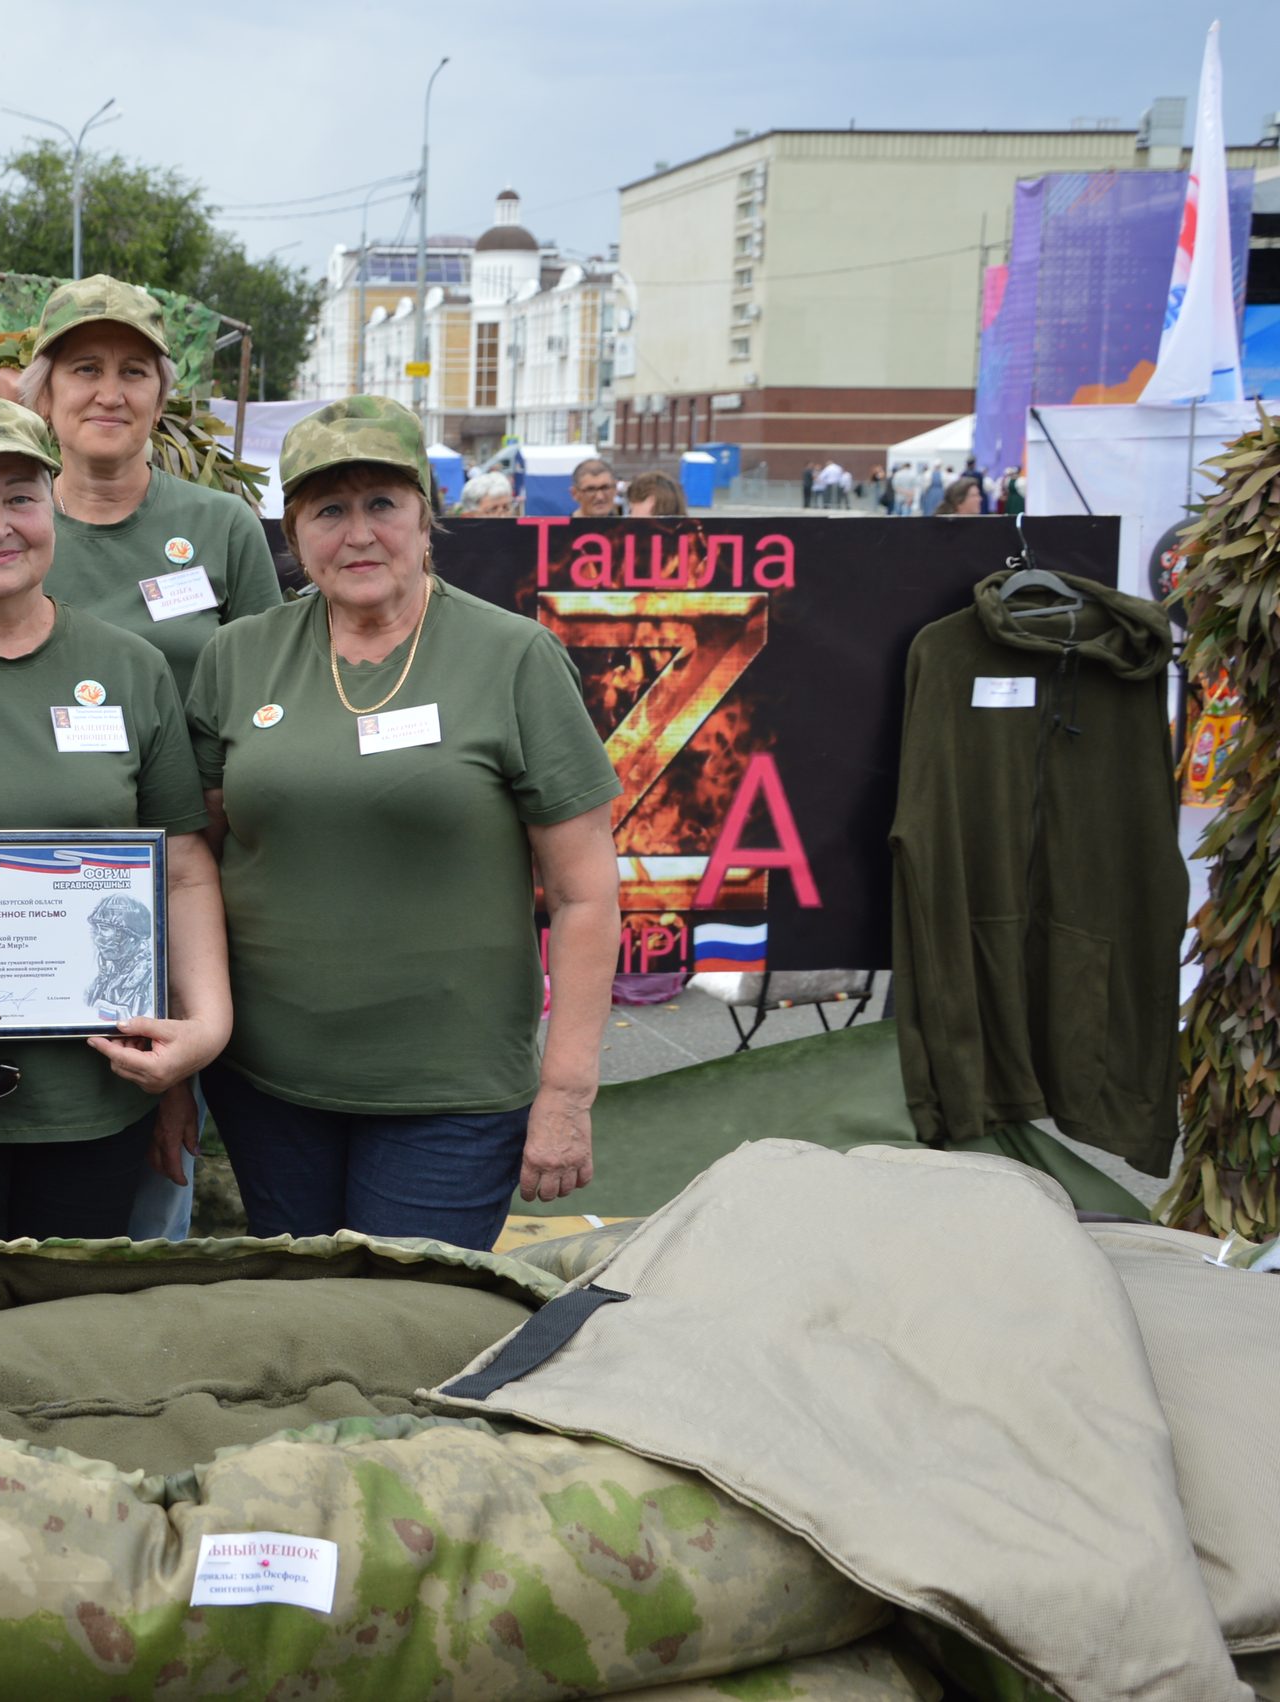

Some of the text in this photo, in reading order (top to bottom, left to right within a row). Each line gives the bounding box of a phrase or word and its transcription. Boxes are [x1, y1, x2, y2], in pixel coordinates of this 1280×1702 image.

[517, 517, 795, 588] Ташла
[84, 868, 130, 879] ФОРУМ
[53, 880, 131, 890] НЕРАВНОДУШНЫХ
[28, 910, 67, 918] ПИСЬМО
[260, 1544, 319, 1560] МЕШОК
[263, 1570, 309, 1583] Оксфорд,
